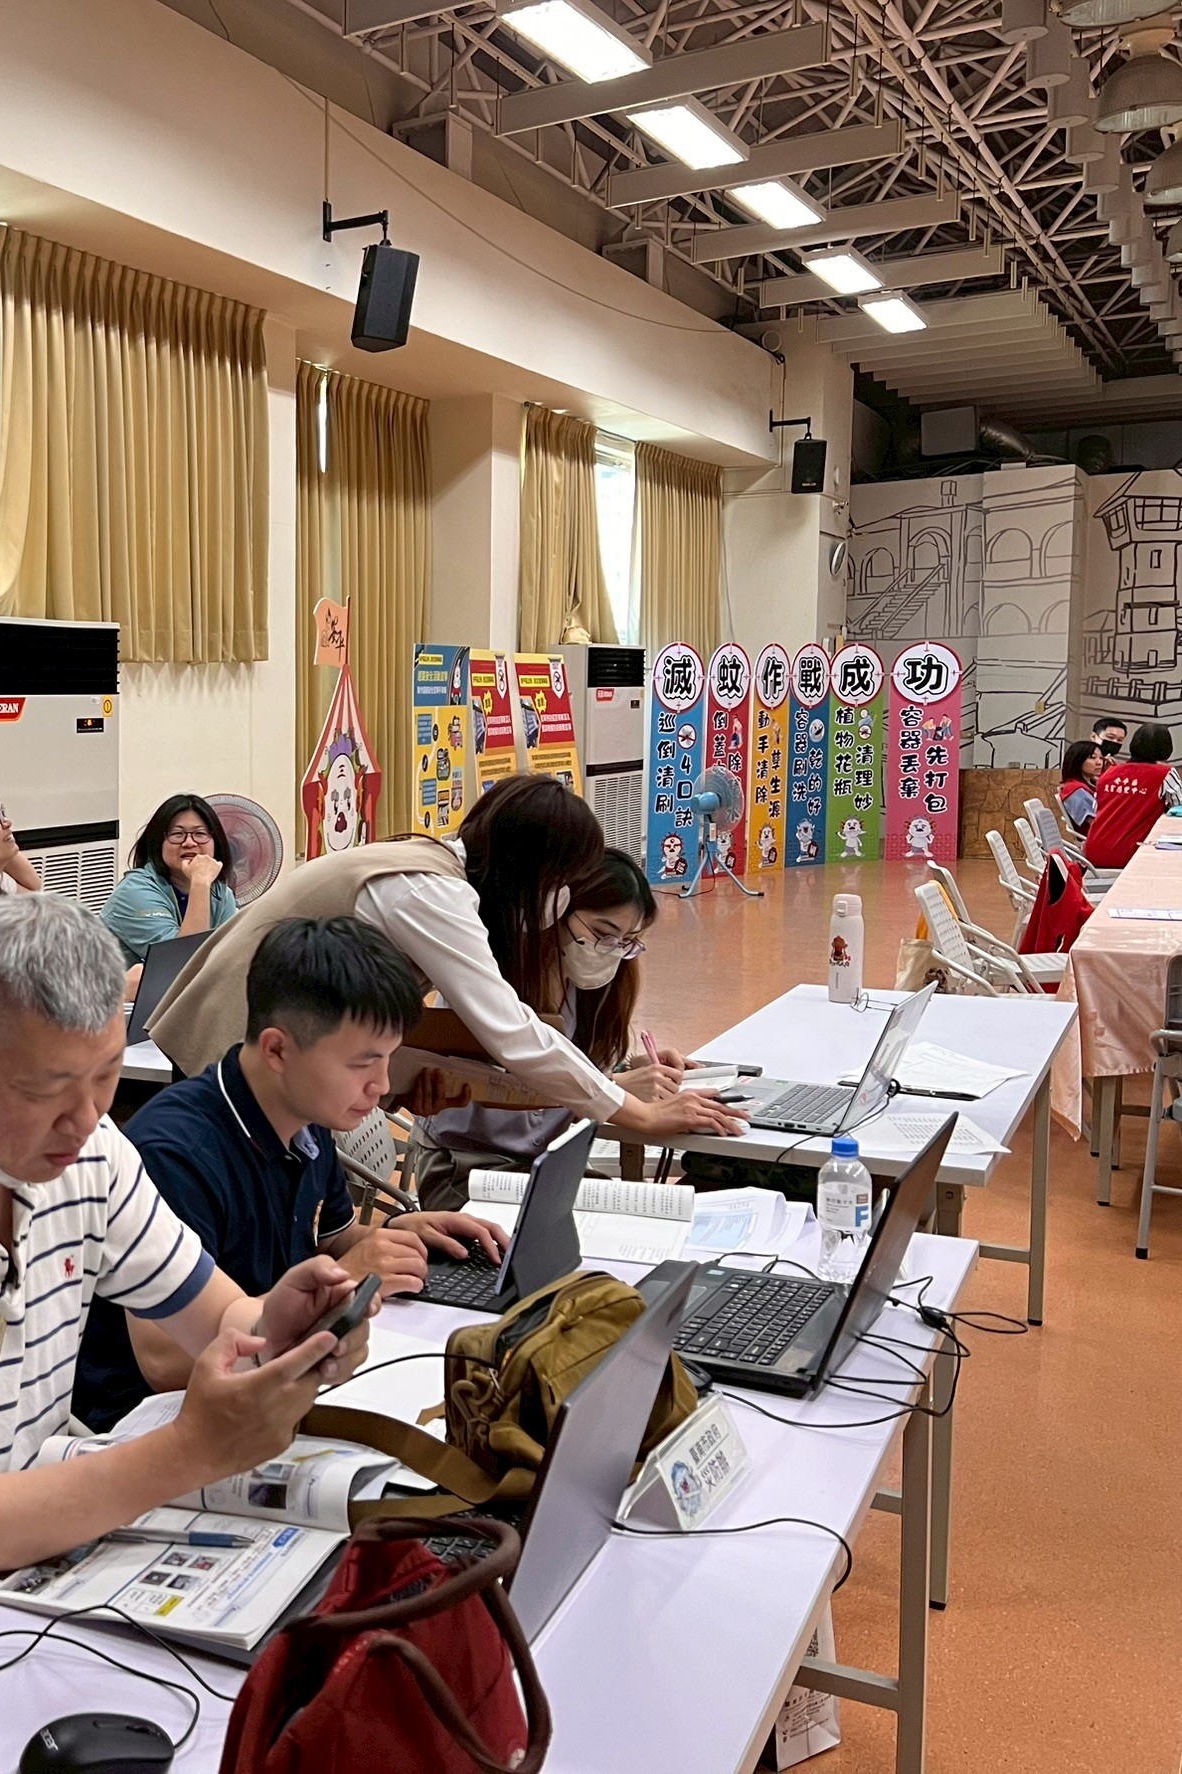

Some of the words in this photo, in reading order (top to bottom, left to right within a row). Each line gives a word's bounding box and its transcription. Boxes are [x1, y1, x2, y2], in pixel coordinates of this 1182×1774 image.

[662, 654, 696, 700] 滅
[717, 654, 745, 699] 蚊
[762, 656, 785, 699] 作
[798, 655, 824, 698] 戰
[839, 655, 875, 697] 成
[903, 654, 949, 695] 功
[656, 712, 676, 814] 巡倒清刷
[675, 753, 694, 827] 4口訣
[755, 710, 771, 804] 動手清除
[792, 708, 809, 802] 容器刷洗
[807, 749, 824, 815] 乾的好
[833, 706, 855, 797] 植物花瓶
[853, 745, 874, 811] 清理妙
[899, 704, 923, 799] 容器丟棄
[923, 745, 949, 813] 先打包
